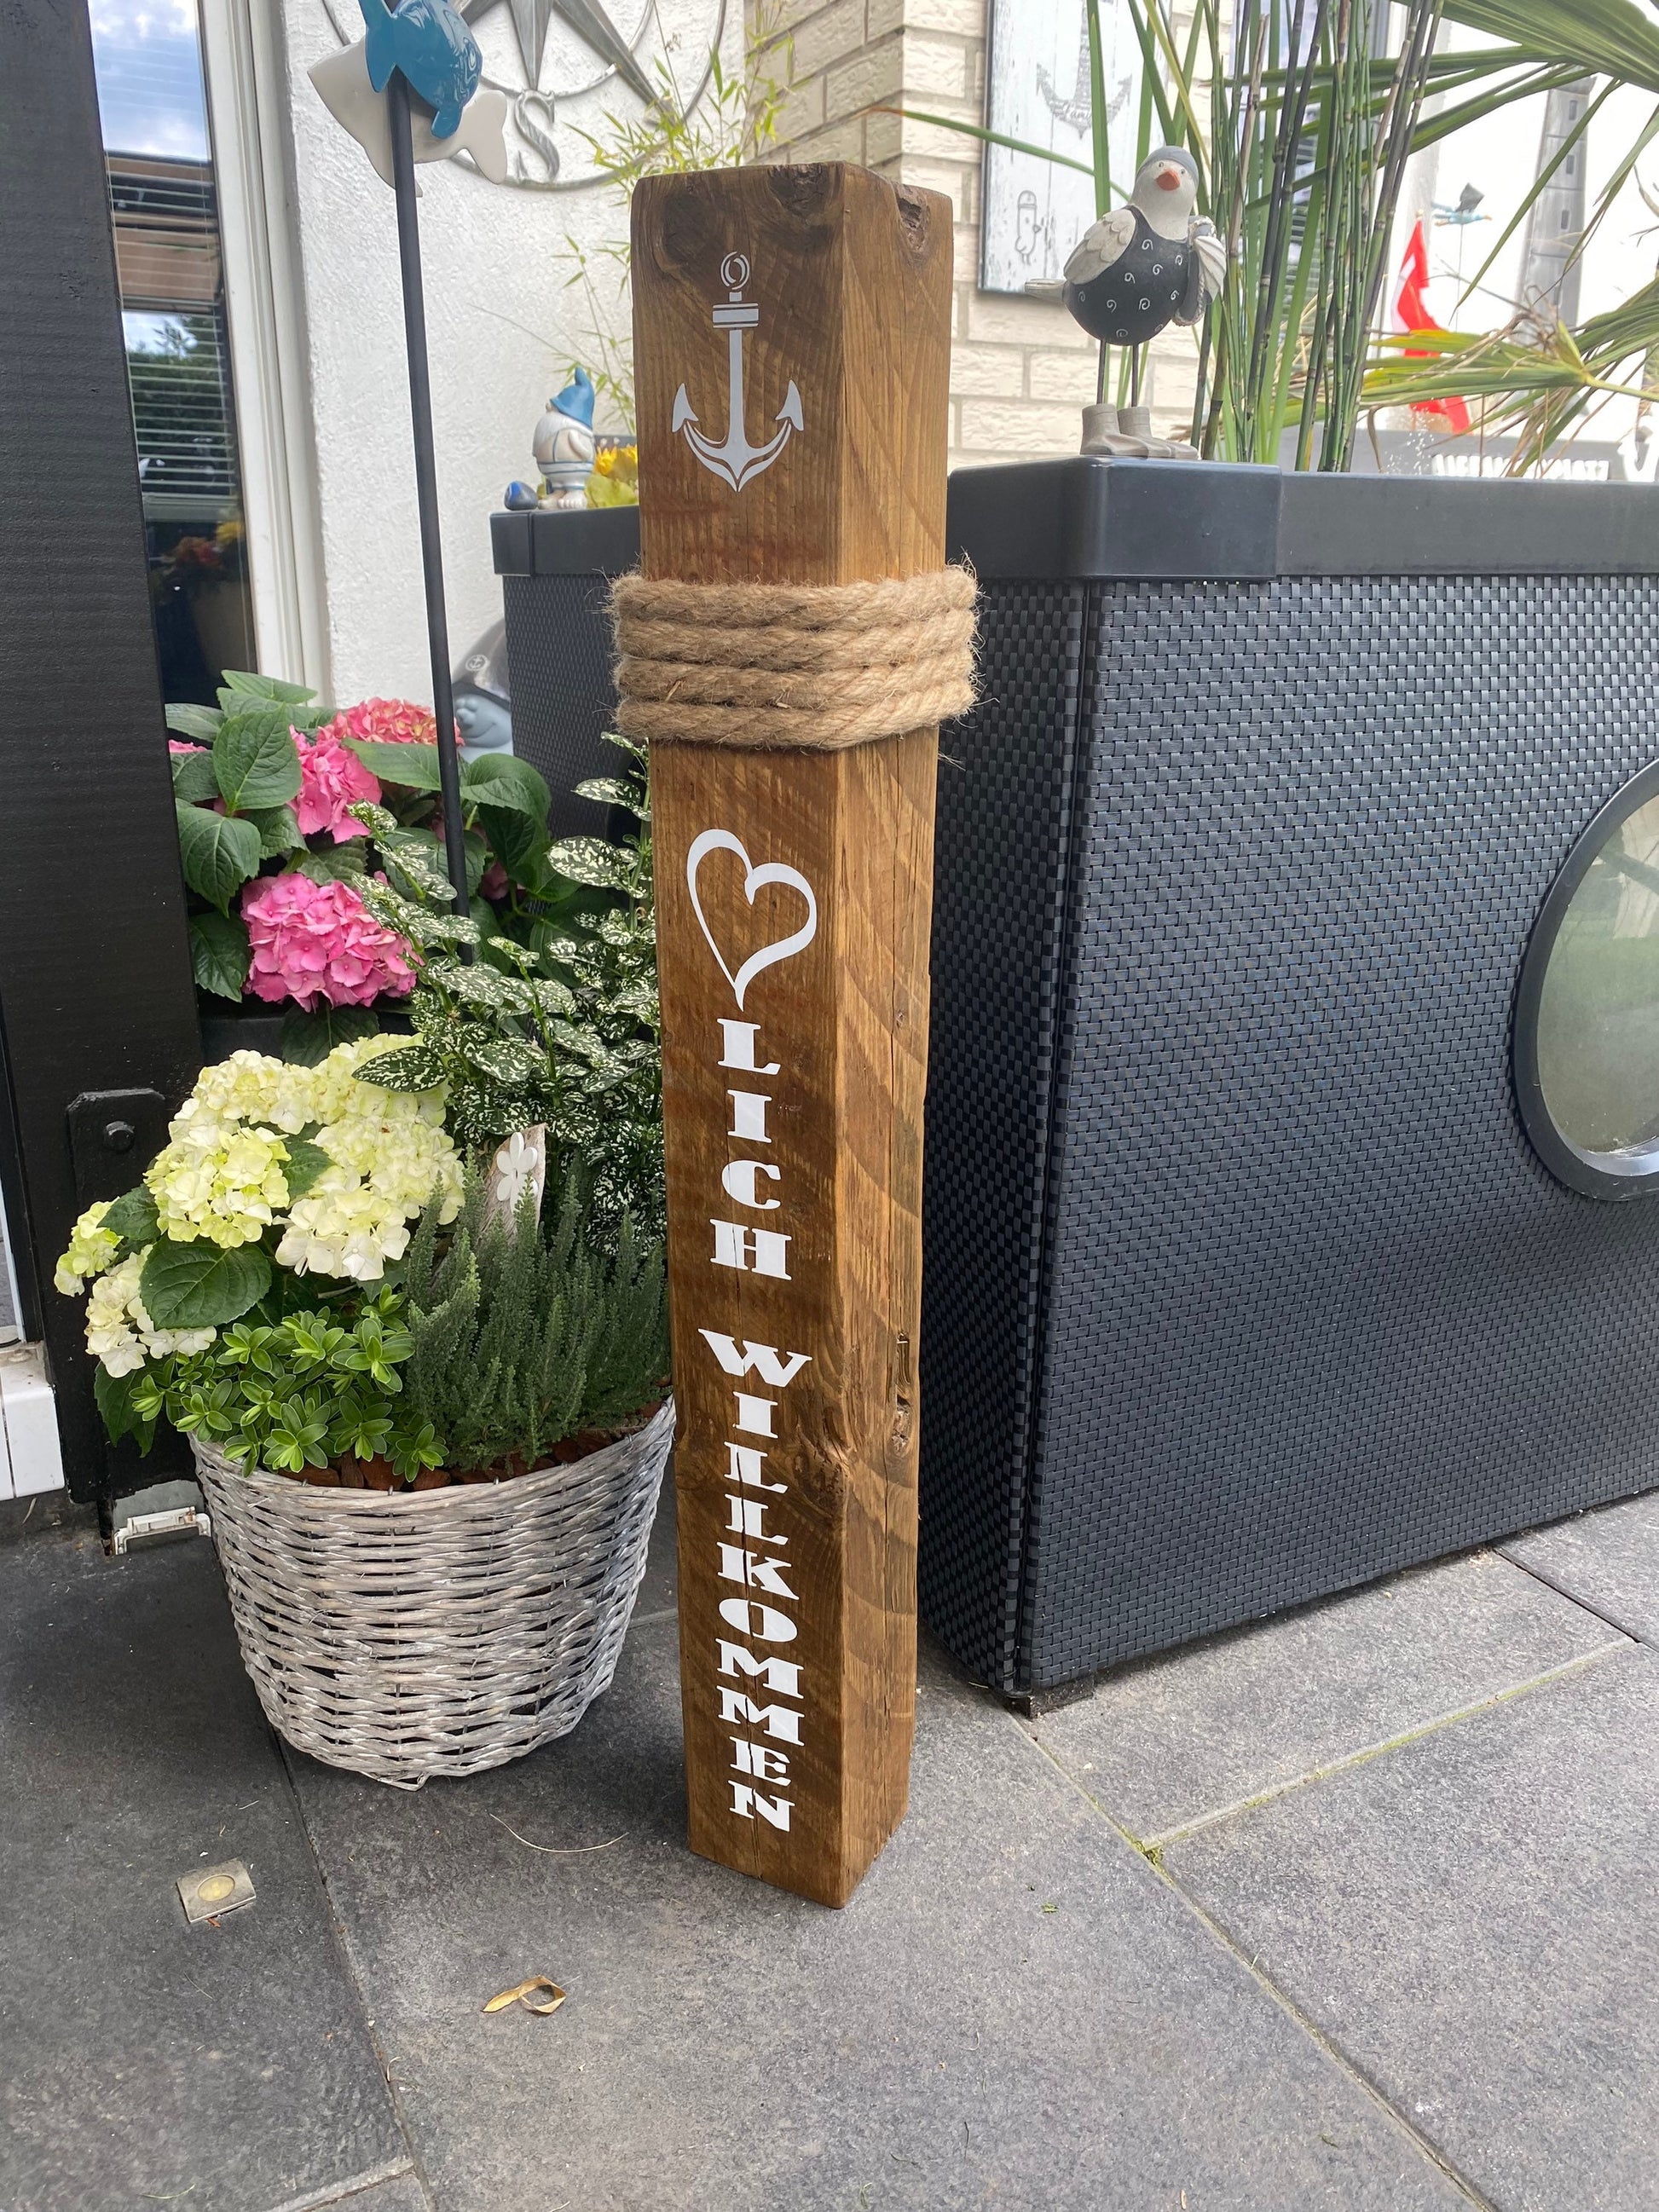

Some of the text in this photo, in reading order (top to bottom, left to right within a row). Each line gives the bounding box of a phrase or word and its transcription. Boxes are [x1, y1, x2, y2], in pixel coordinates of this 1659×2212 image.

[513, 89, 559, 183] S
[697, 1018, 812, 1833] LICH WILLKOMMEN
